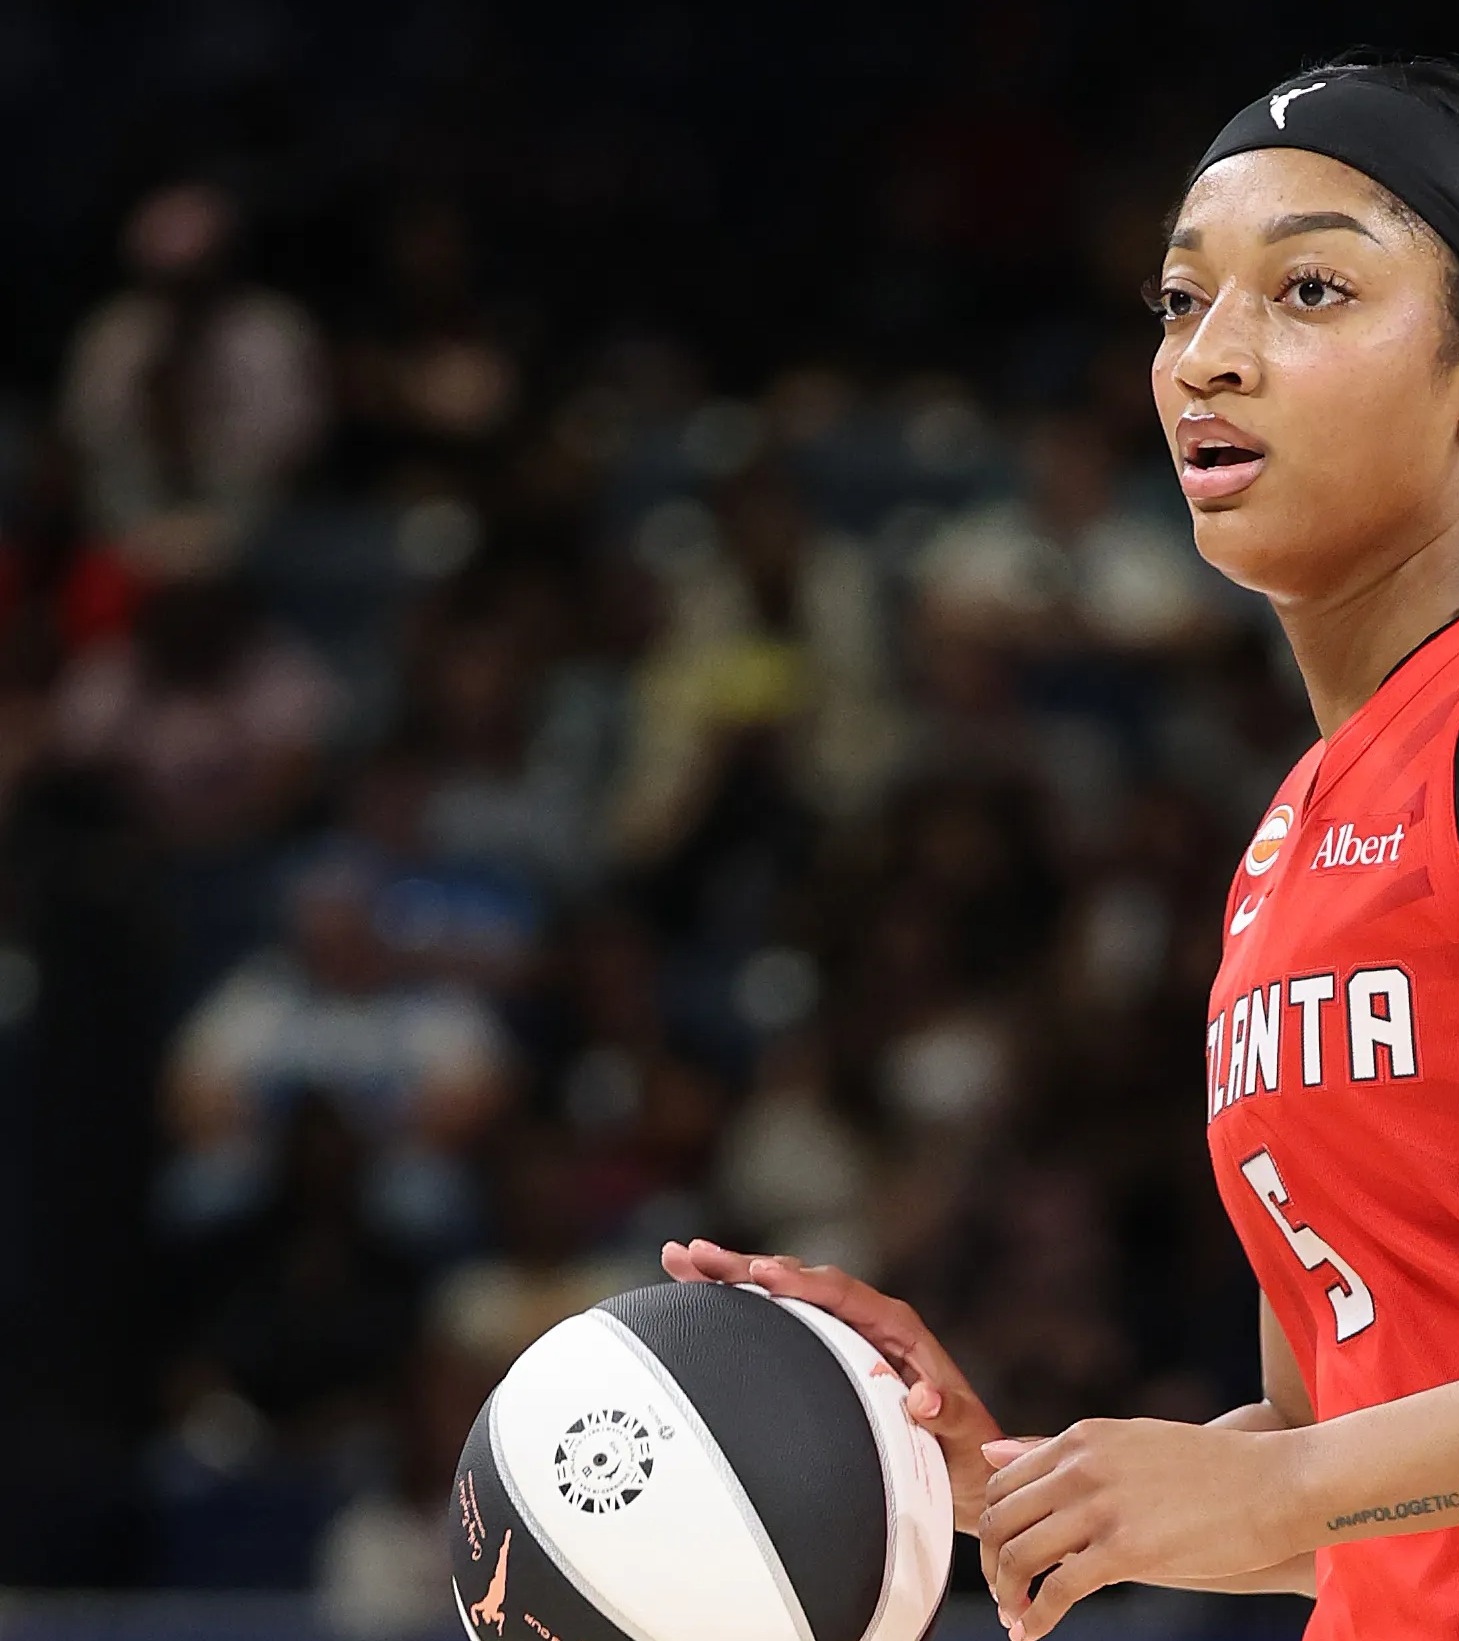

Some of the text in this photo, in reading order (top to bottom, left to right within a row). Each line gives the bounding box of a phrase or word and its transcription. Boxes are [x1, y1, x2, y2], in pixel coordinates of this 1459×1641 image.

[1310, 823, 1404, 870] Albert
[1206, 966, 1418, 1125] TLANTA
[1241, 1149, 1374, 1342] 5
